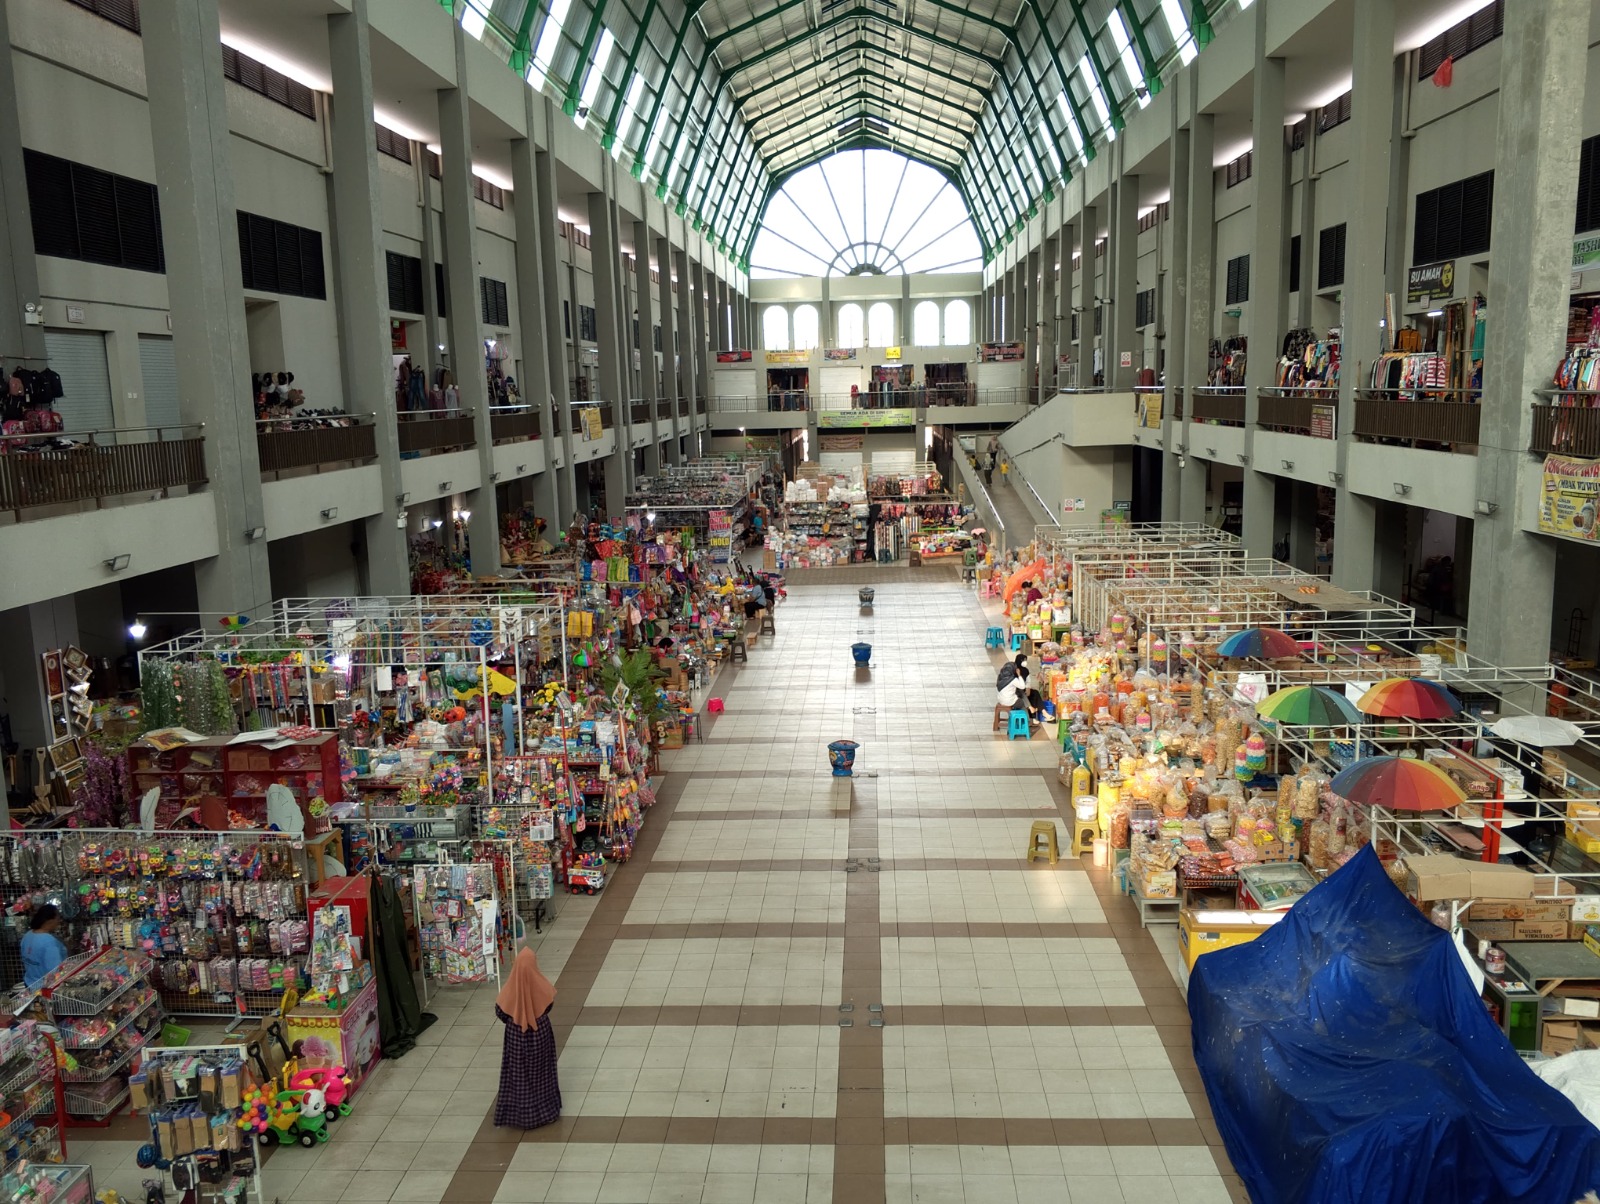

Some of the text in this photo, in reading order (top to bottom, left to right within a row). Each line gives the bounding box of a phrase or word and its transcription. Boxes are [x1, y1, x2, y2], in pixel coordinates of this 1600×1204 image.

[1410, 271, 1421, 283] BU
[1421, 267, 1442, 281] AMAH
[1469, 783, 1490, 792] Tango
